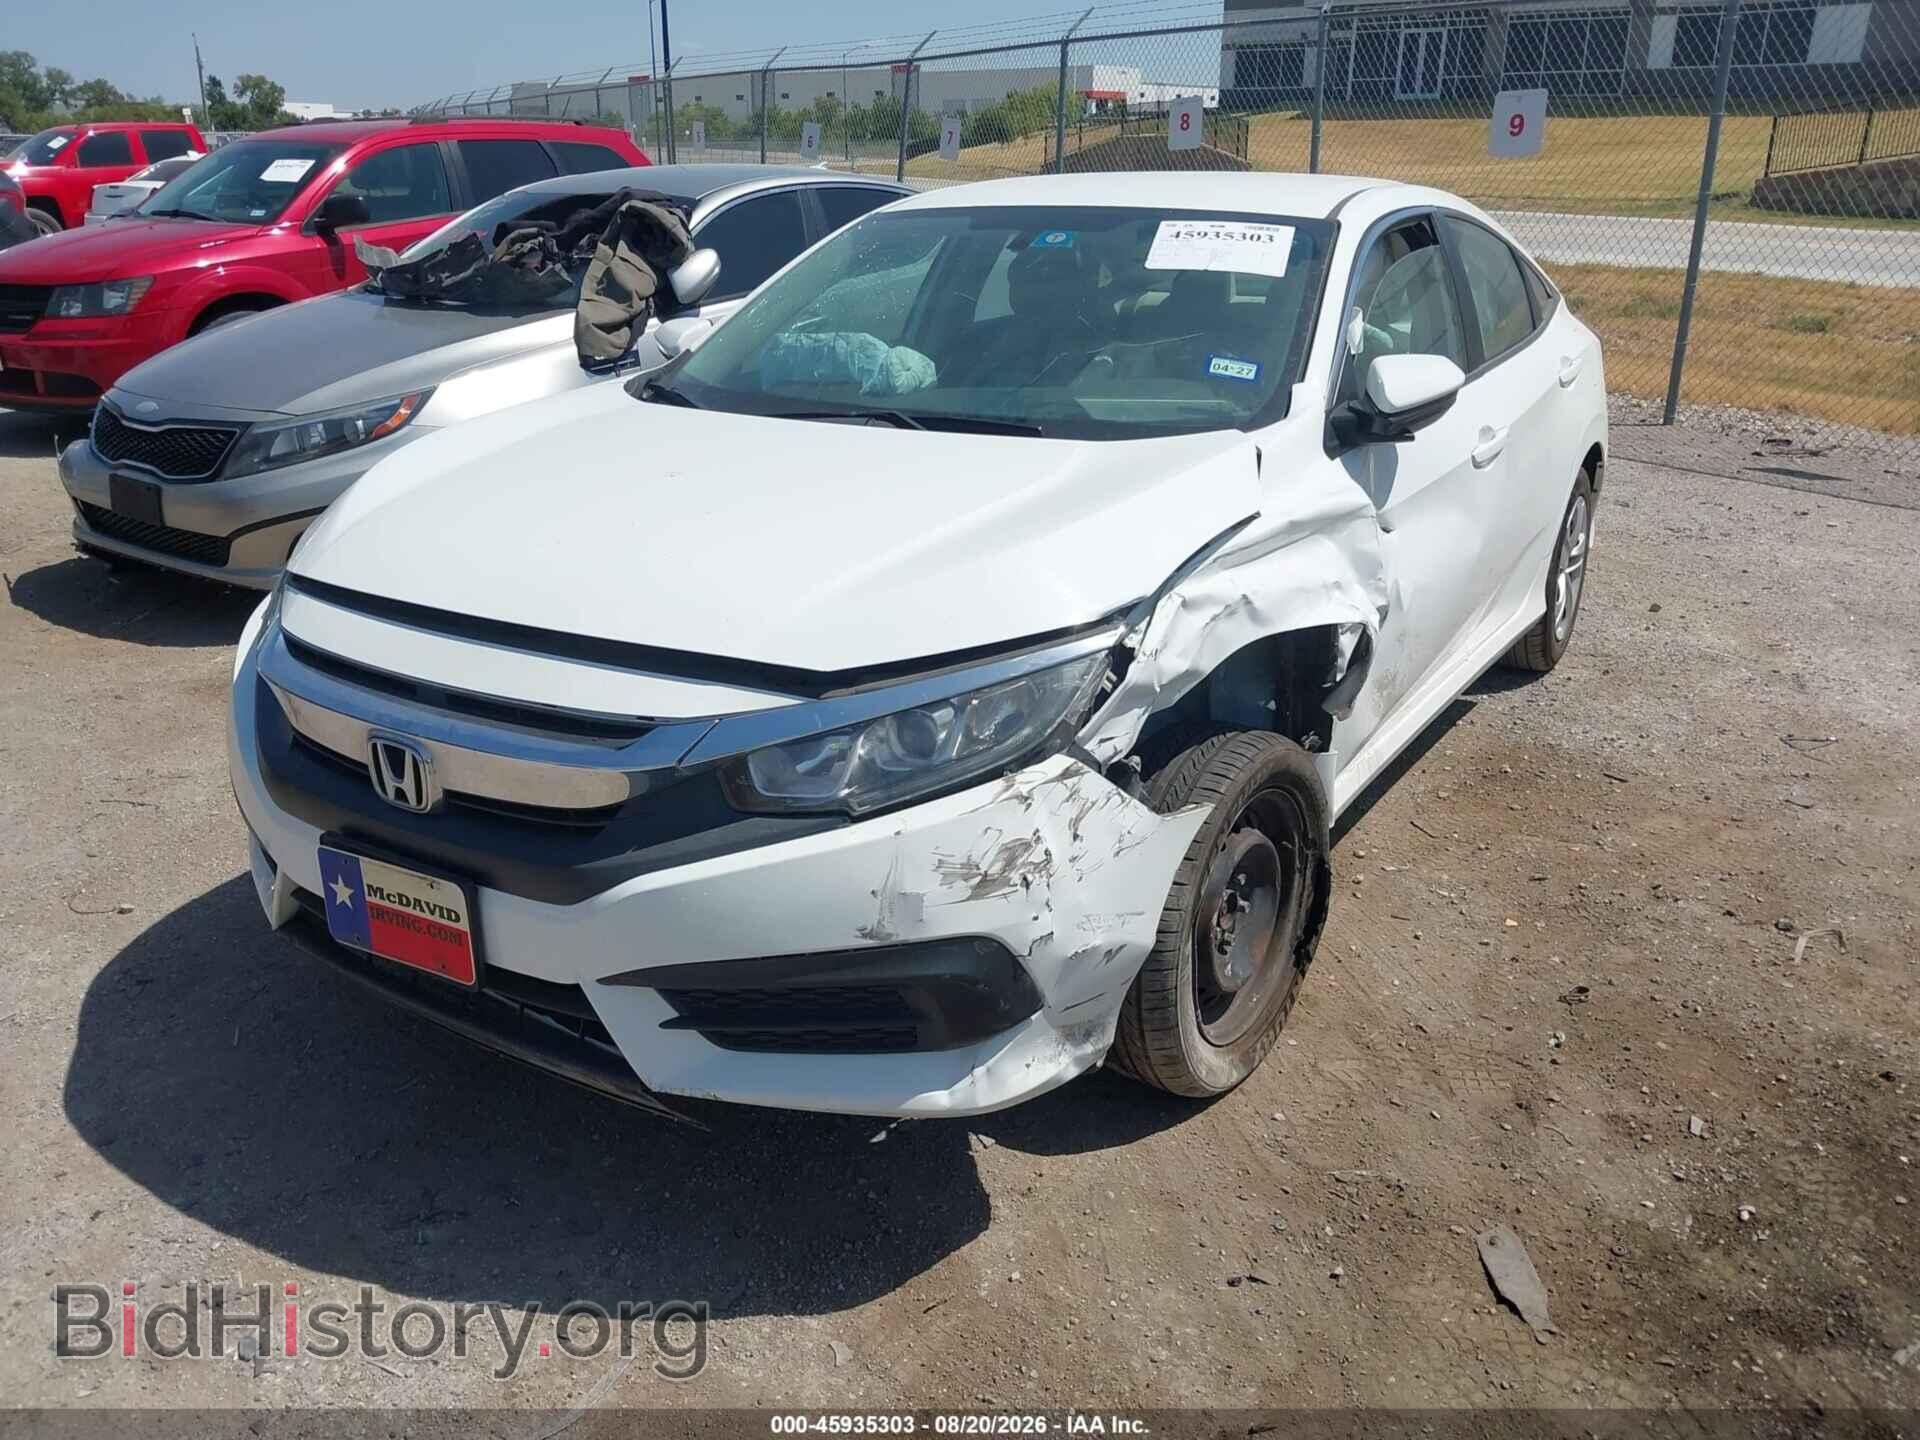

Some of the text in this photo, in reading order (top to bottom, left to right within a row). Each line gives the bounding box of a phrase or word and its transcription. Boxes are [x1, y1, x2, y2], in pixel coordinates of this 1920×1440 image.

[1180, 112, 1190, 131] 8
[1509, 113, 1525, 137] 9
[807, 135, 814, 149] 6
[947, 130, 953, 145] 7
[1169, 229, 1275, 244] 45935303
[366, 883, 462, 923] McDAVID
[369, 906, 463, 947] IRVING.COM
